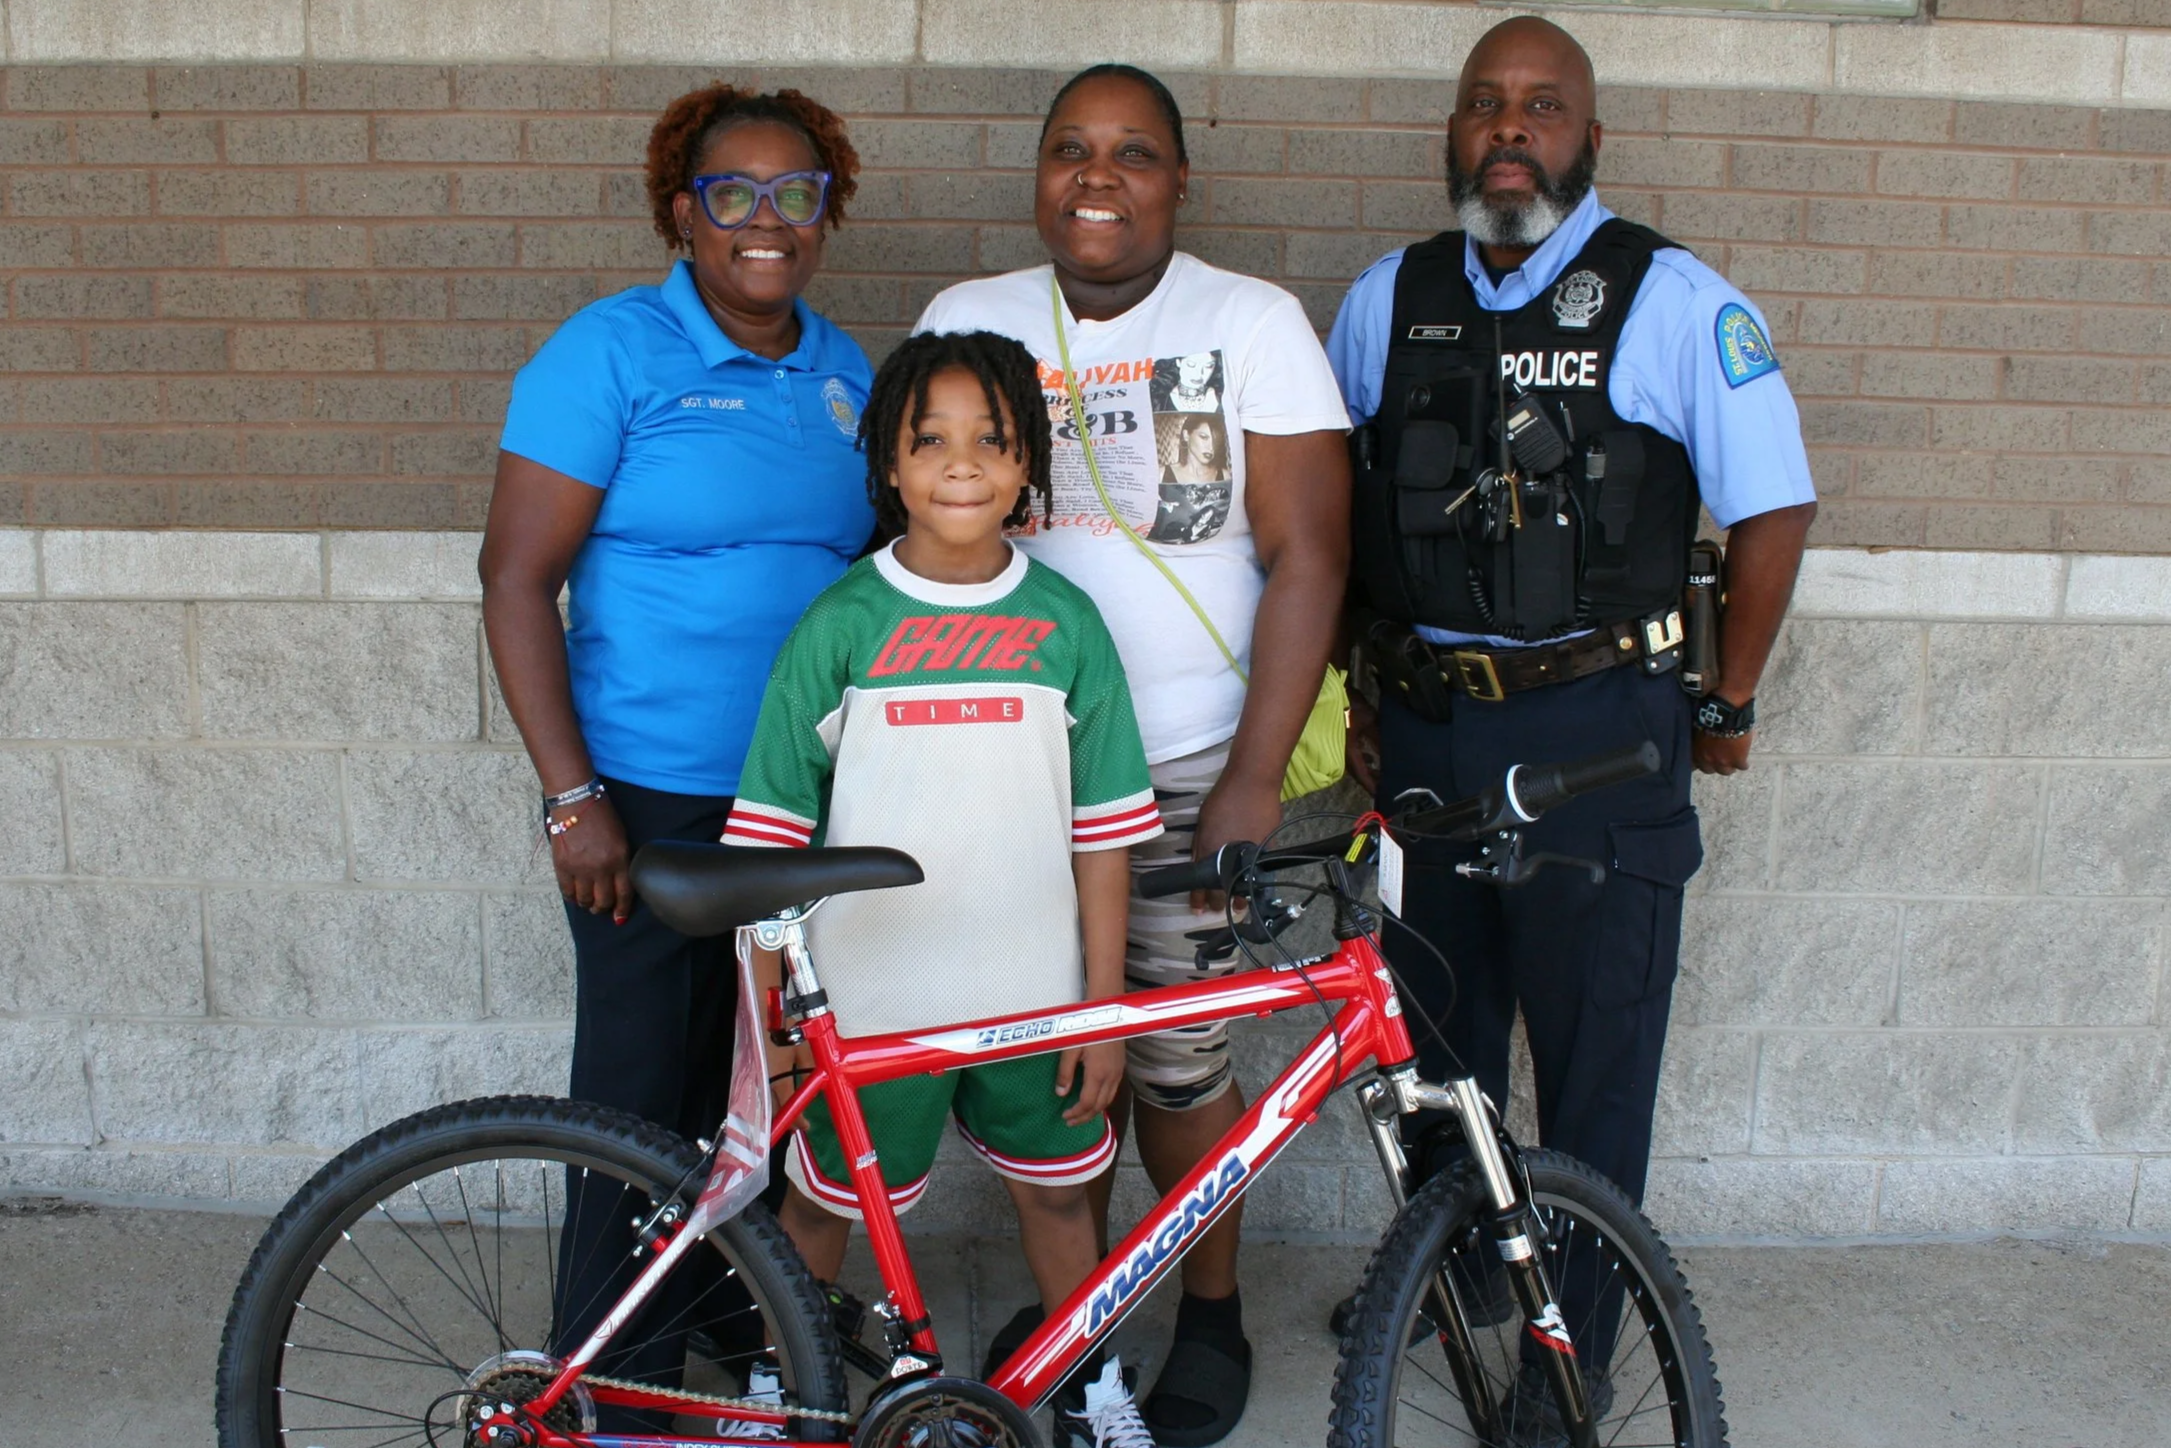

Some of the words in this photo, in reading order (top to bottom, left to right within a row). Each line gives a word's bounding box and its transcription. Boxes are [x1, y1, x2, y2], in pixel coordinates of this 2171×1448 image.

[1421, 329, 1448, 338] BROWN
[1036, 357, 1154, 390] ALIYAH
[1501, 351, 1598, 387] POLICE
[681, 397, 705, 409] SGT.
[709, 398, 746, 410] MOORE
[1050, 410, 1138, 441] &B
[866, 614, 1058, 678] GAME.
[893, 702, 1014, 721] TIME
[998, 1019, 1056, 1044] ECHO
[1086, 1150, 1249, 1337] MAGNA
